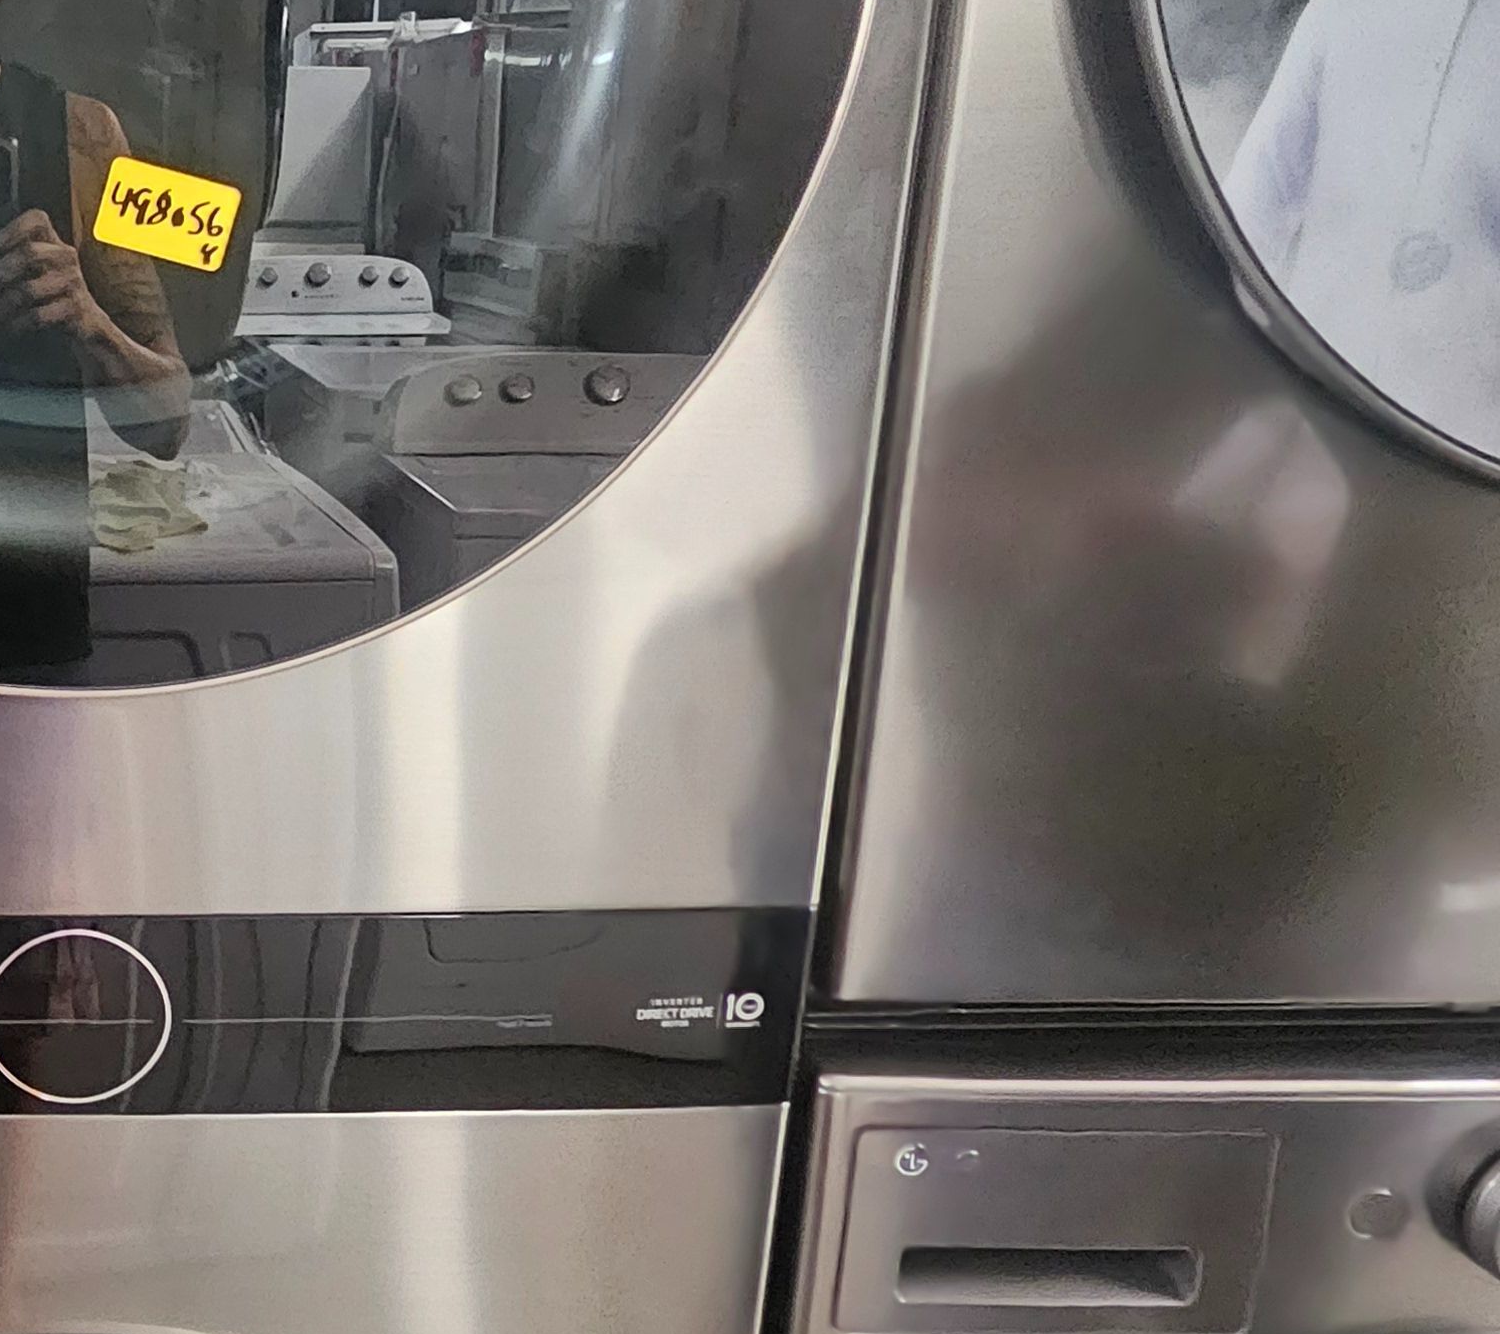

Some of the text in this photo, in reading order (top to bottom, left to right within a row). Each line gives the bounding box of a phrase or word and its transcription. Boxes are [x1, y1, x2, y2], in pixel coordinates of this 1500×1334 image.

[636, 1006, 715, 1020] DIRECT DRIVE
[726, 992, 765, 1021] 10
